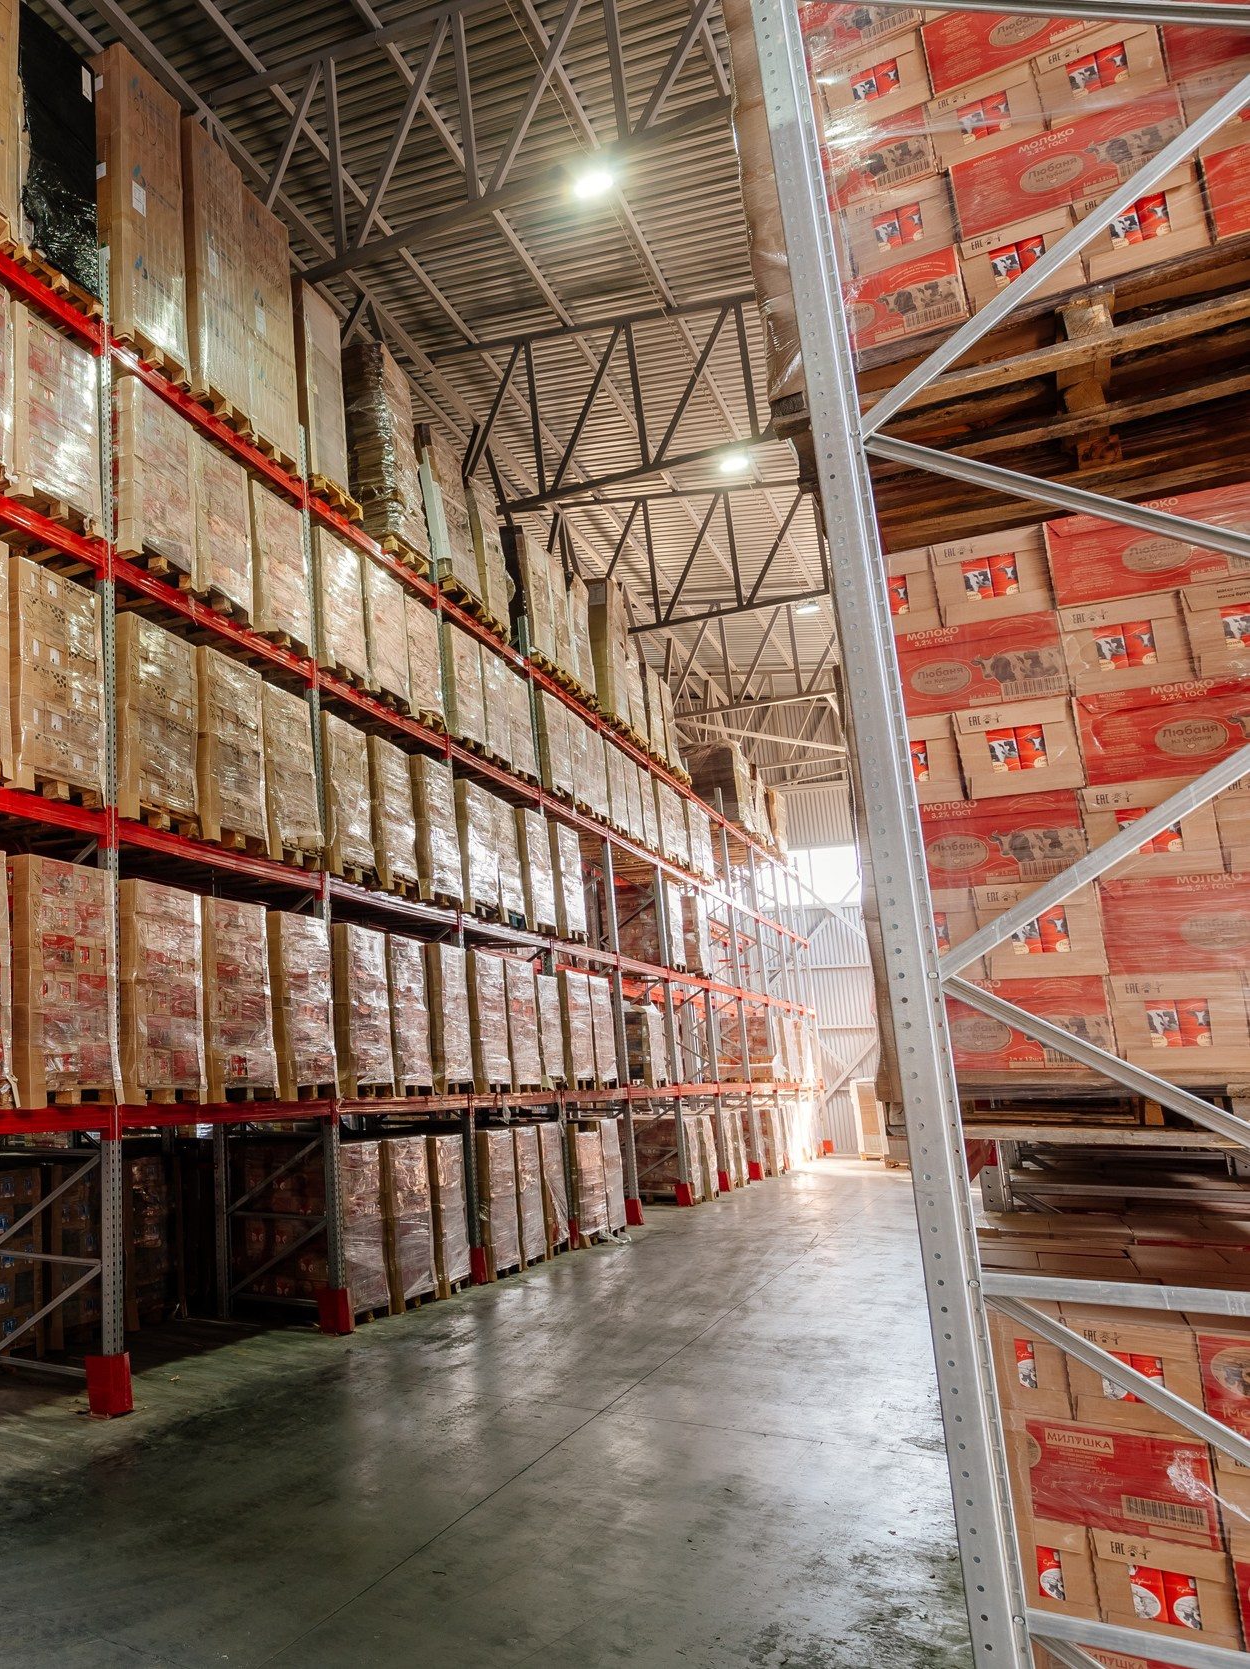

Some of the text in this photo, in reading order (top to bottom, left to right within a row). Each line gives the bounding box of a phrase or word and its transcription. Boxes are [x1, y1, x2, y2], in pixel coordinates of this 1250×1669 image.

[1018, 128, 1074, 154] МОЛОКО
[1048, 137, 1069, 149] ГОСТ
[1028, 157, 1078, 180] Любаня
[906, 626, 959, 642] МОЛОКО
[914, 635, 954, 647] 3,2% ГОСТ
[918, 666, 964, 680] Любаня
[1150, 678, 1215, 696] МОЛОКО
[1160, 689, 1208, 702] 3,2% ГОСТ
[1162, 723, 1219, 739] Любаня
[923, 799, 978, 812] МОЛОКО
[931, 809, 972, 819] 3,2% ГОСТ
[933, 841, 980, 853] Любаня
[1176, 873, 1243, 885] МОЛОКО
[1212, 882, 1235, 890] ГОСТ
[1047, 1432, 1111, 1450] МИЛУШКА
[1111, 1541, 1125, 1556] EAC
